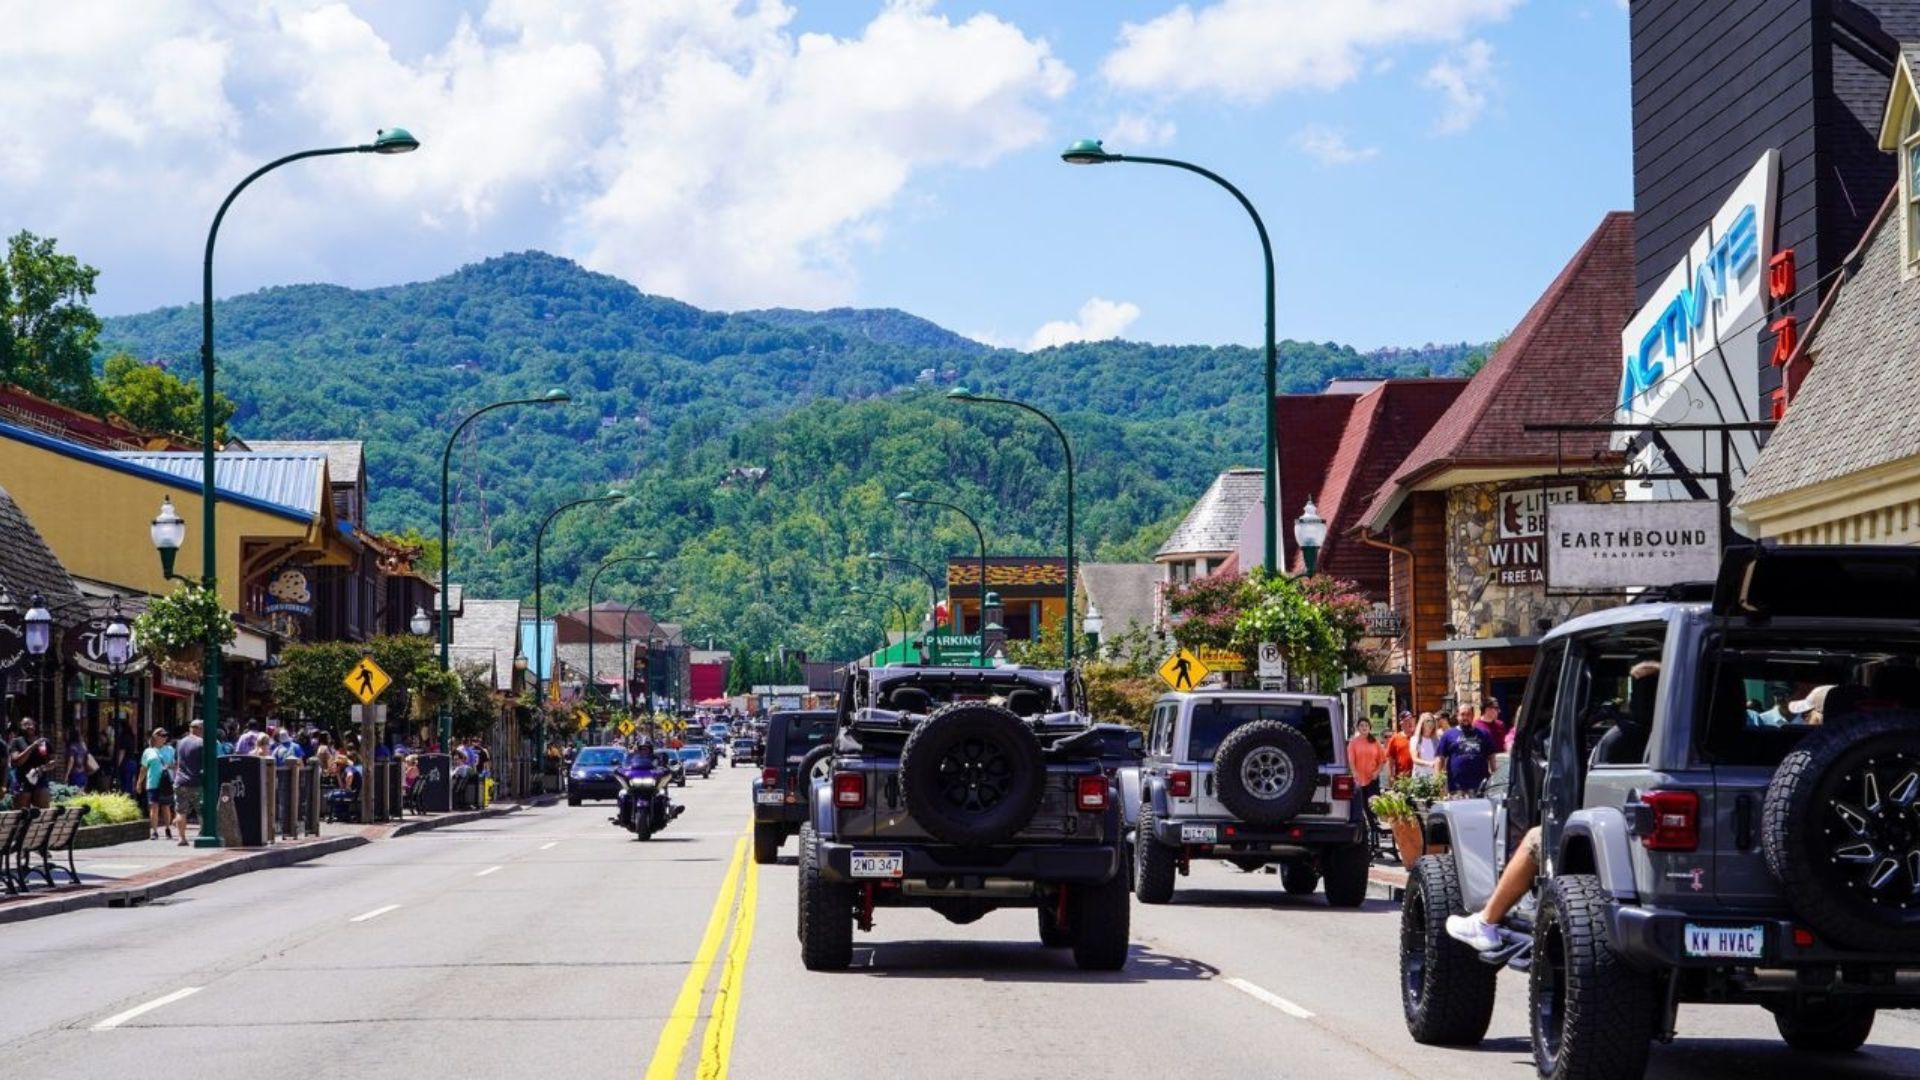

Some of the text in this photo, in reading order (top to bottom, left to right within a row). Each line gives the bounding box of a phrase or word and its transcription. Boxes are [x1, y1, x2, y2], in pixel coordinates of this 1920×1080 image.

[1621, 204, 1757, 411] ACTIVATE
[1561, 530, 1706, 548] EARTHBOUND
[1488, 541, 1538, 566] WIN
[1501, 569, 1544, 584] FREE TA
[926, 635, 982, 646] PARKING
[878, 858, 899, 871] 347
[1692, 931, 1754, 952] KW HVAC
